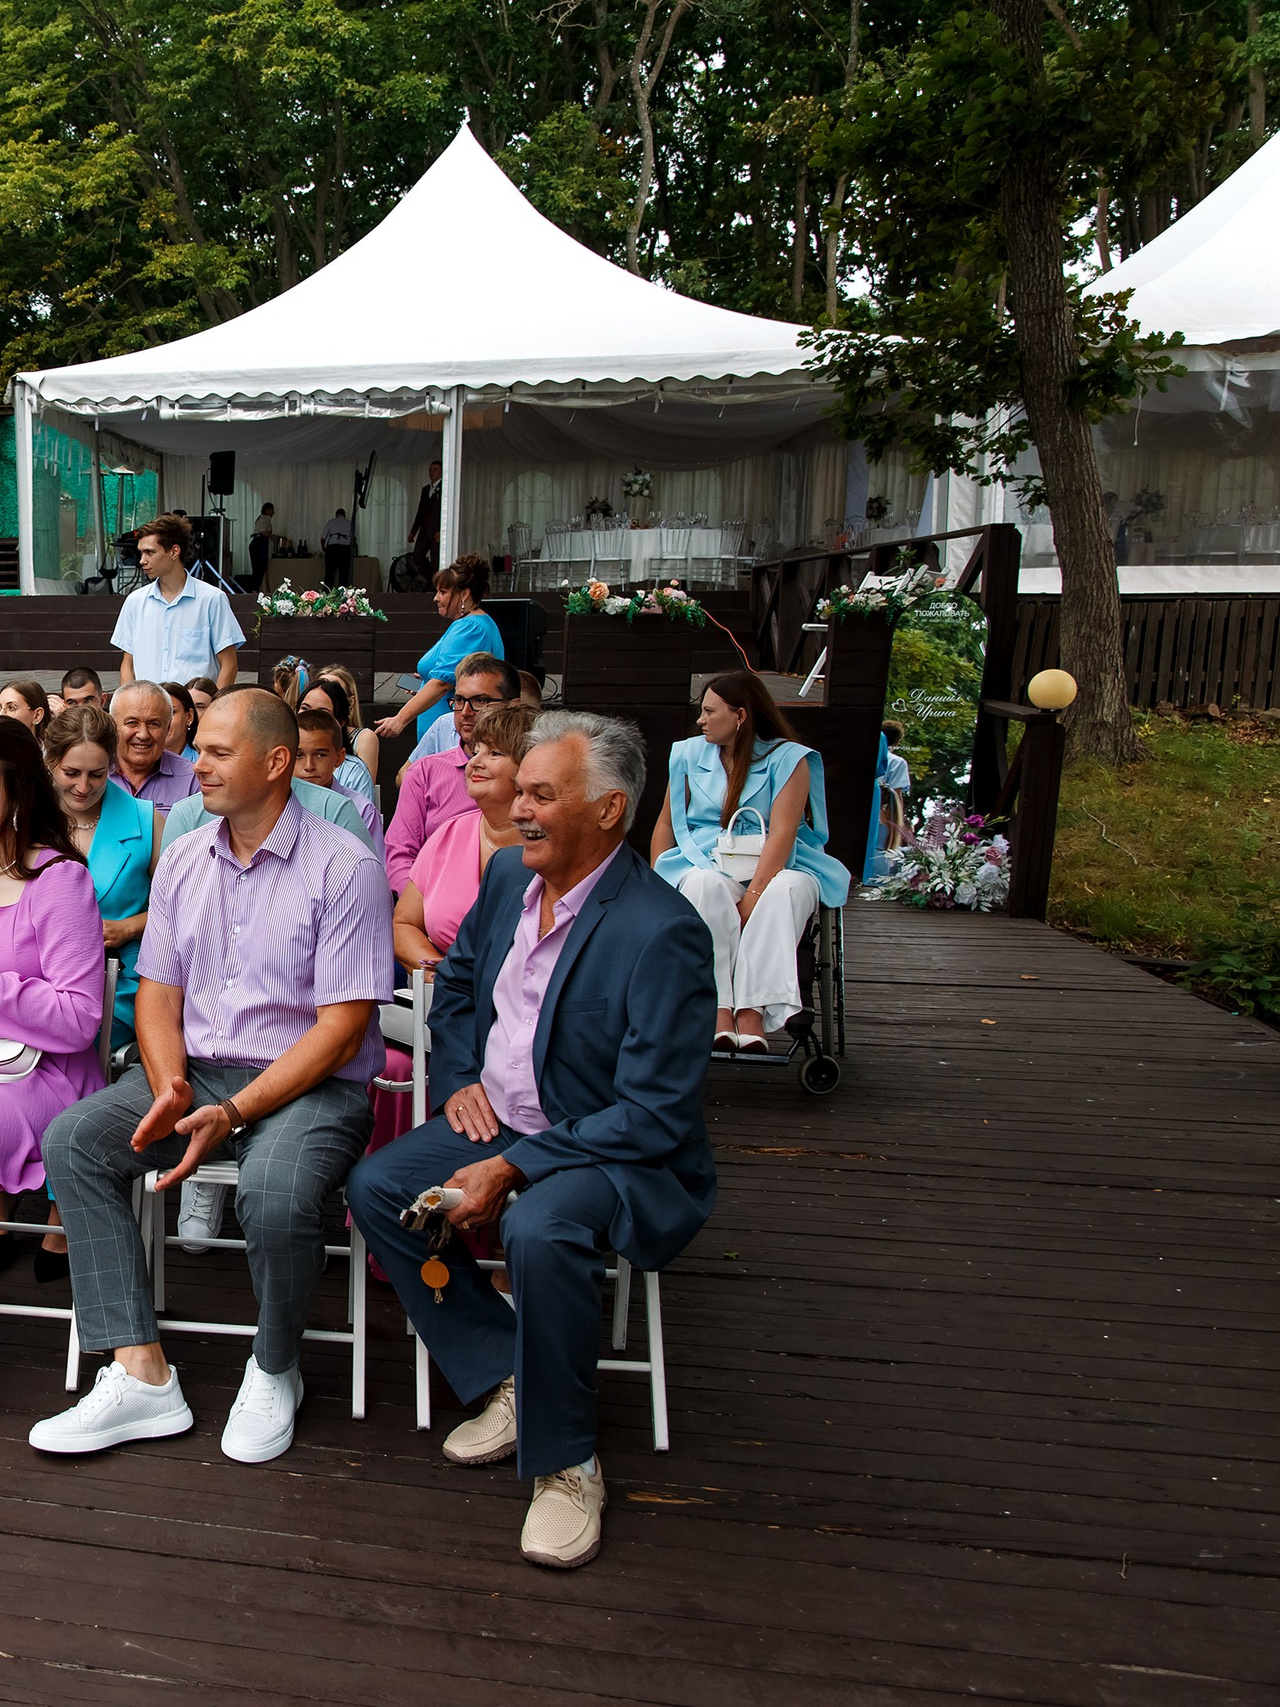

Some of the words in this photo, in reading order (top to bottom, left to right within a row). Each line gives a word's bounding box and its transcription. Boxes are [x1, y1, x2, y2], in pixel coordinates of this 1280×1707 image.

[929, 602, 958, 610] ДОБРО
[908, 688, 962, 703] Даниил
[911, 703, 958, 721] Ирина
